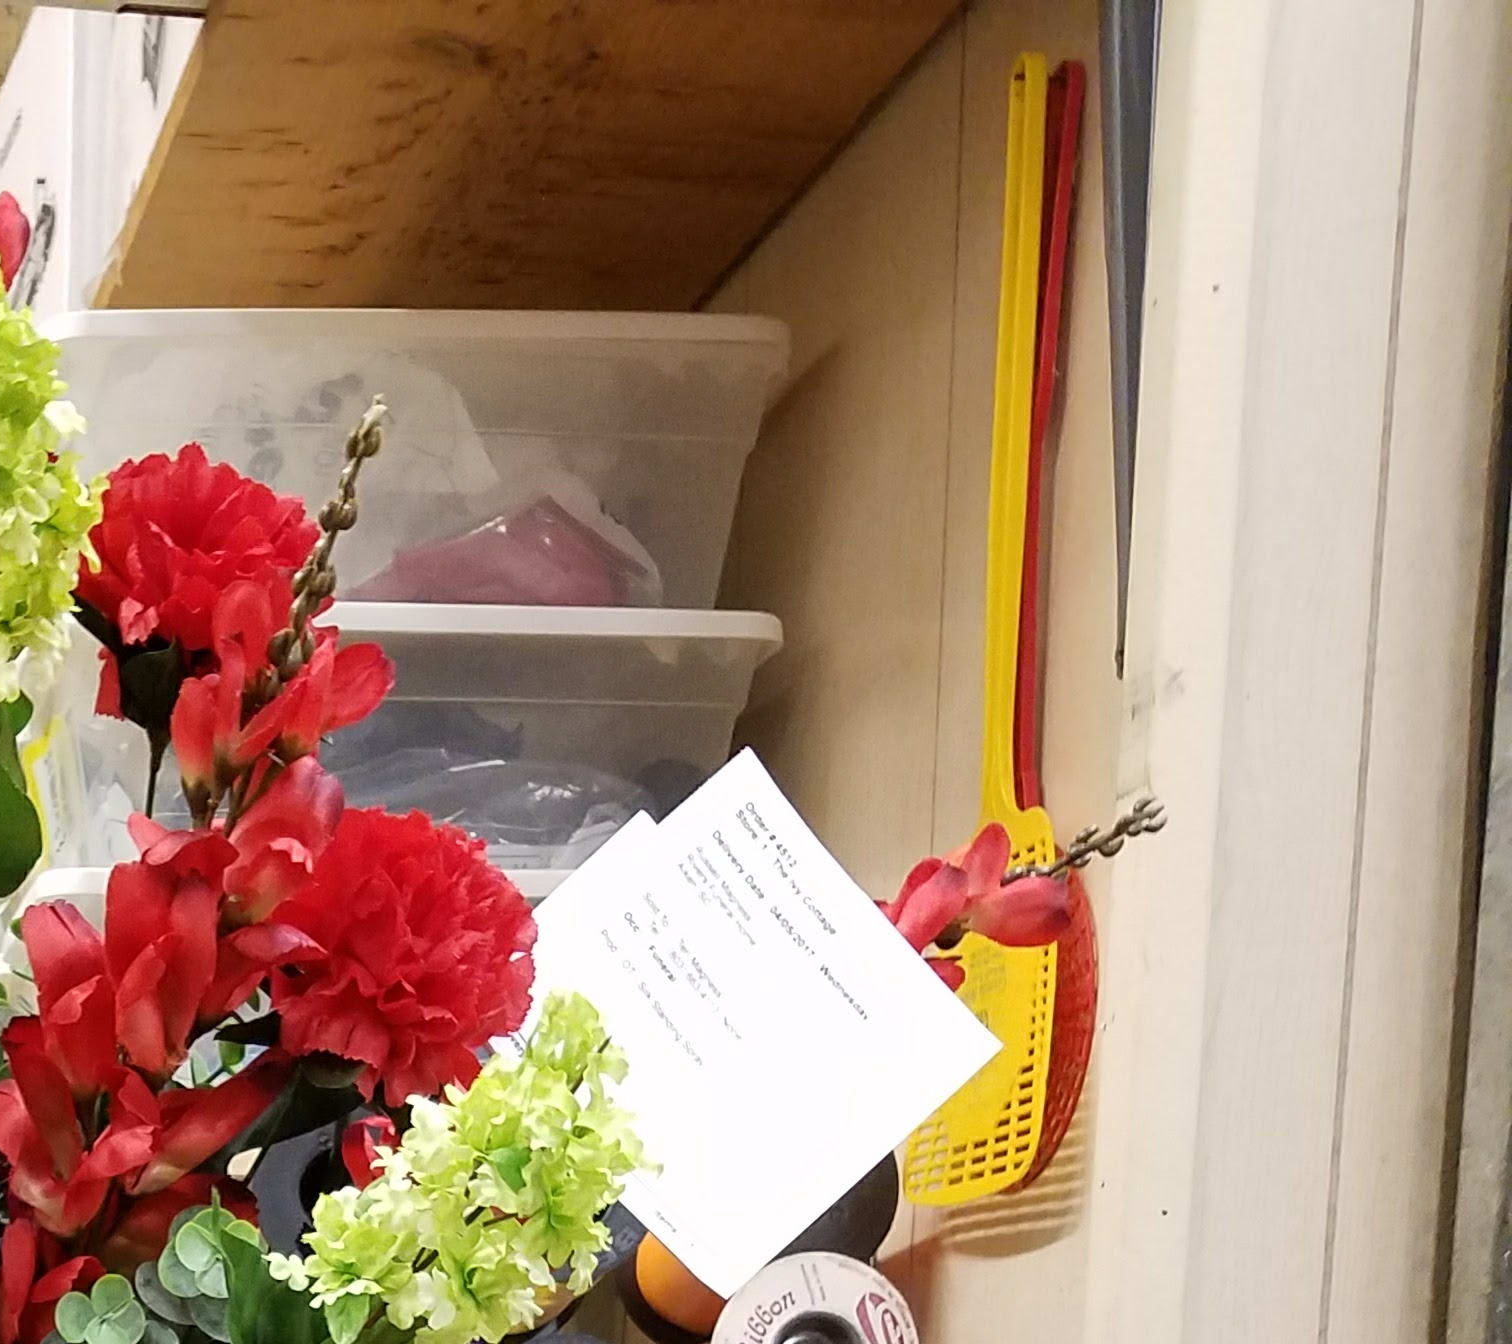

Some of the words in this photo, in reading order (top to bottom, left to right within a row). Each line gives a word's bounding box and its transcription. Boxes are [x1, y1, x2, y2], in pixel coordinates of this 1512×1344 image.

[745, 801, 770, 832] Order
[775, 843, 797, 868] 4512
[773, 857, 789, 879] The
[802, 896, 837, 935] Cottage
[819, 964, 868, 1021] Wednesday
